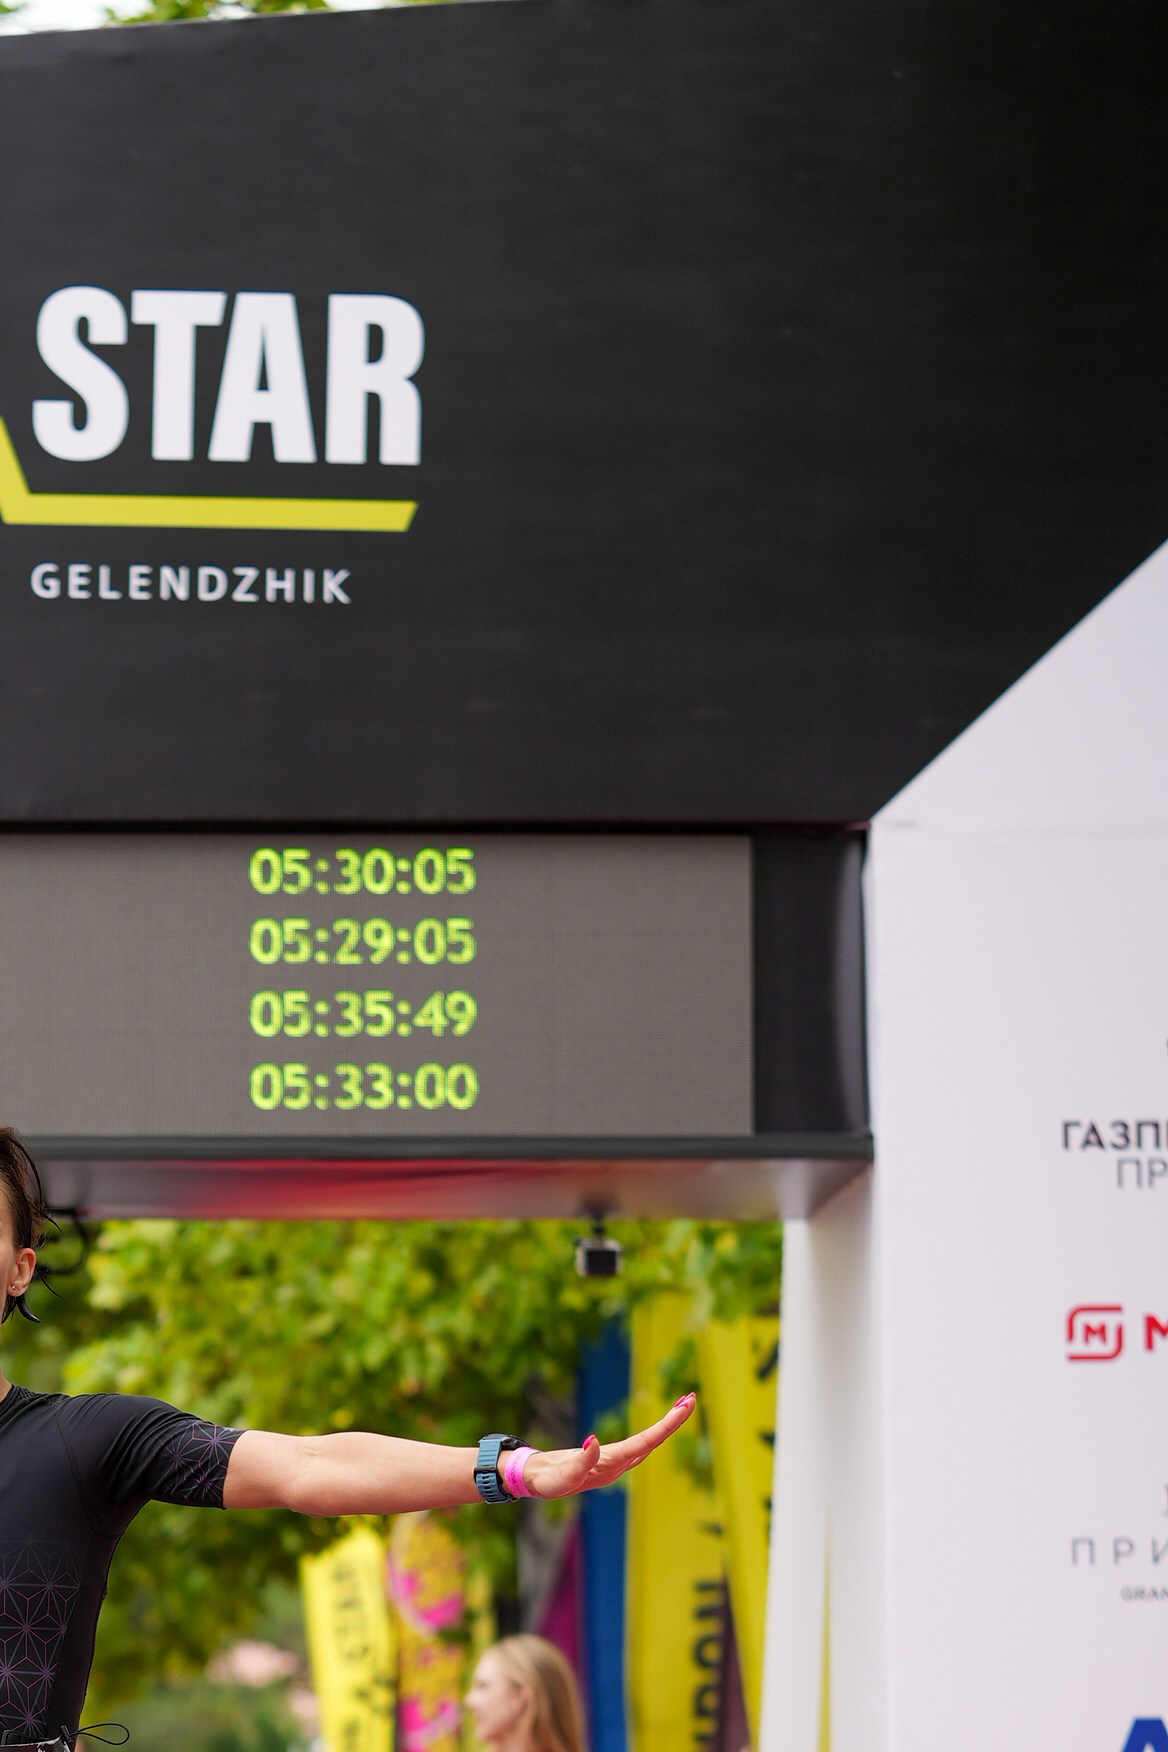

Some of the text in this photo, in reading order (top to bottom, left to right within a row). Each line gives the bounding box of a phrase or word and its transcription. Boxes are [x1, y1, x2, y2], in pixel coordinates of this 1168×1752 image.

[32, 284, 426, 466] STAR
[31, 562, 352, 604] GELENDZHIK
[248, 847, 477, 894] 05:30:05
[248, 917, 477, 965] 05:29:05
[248, 989, 478, 1038] 05:35:49
[248, 1062, 480, 1110] 05:33:00
[1061, 1119, 1168, 1151] ГАЗП
